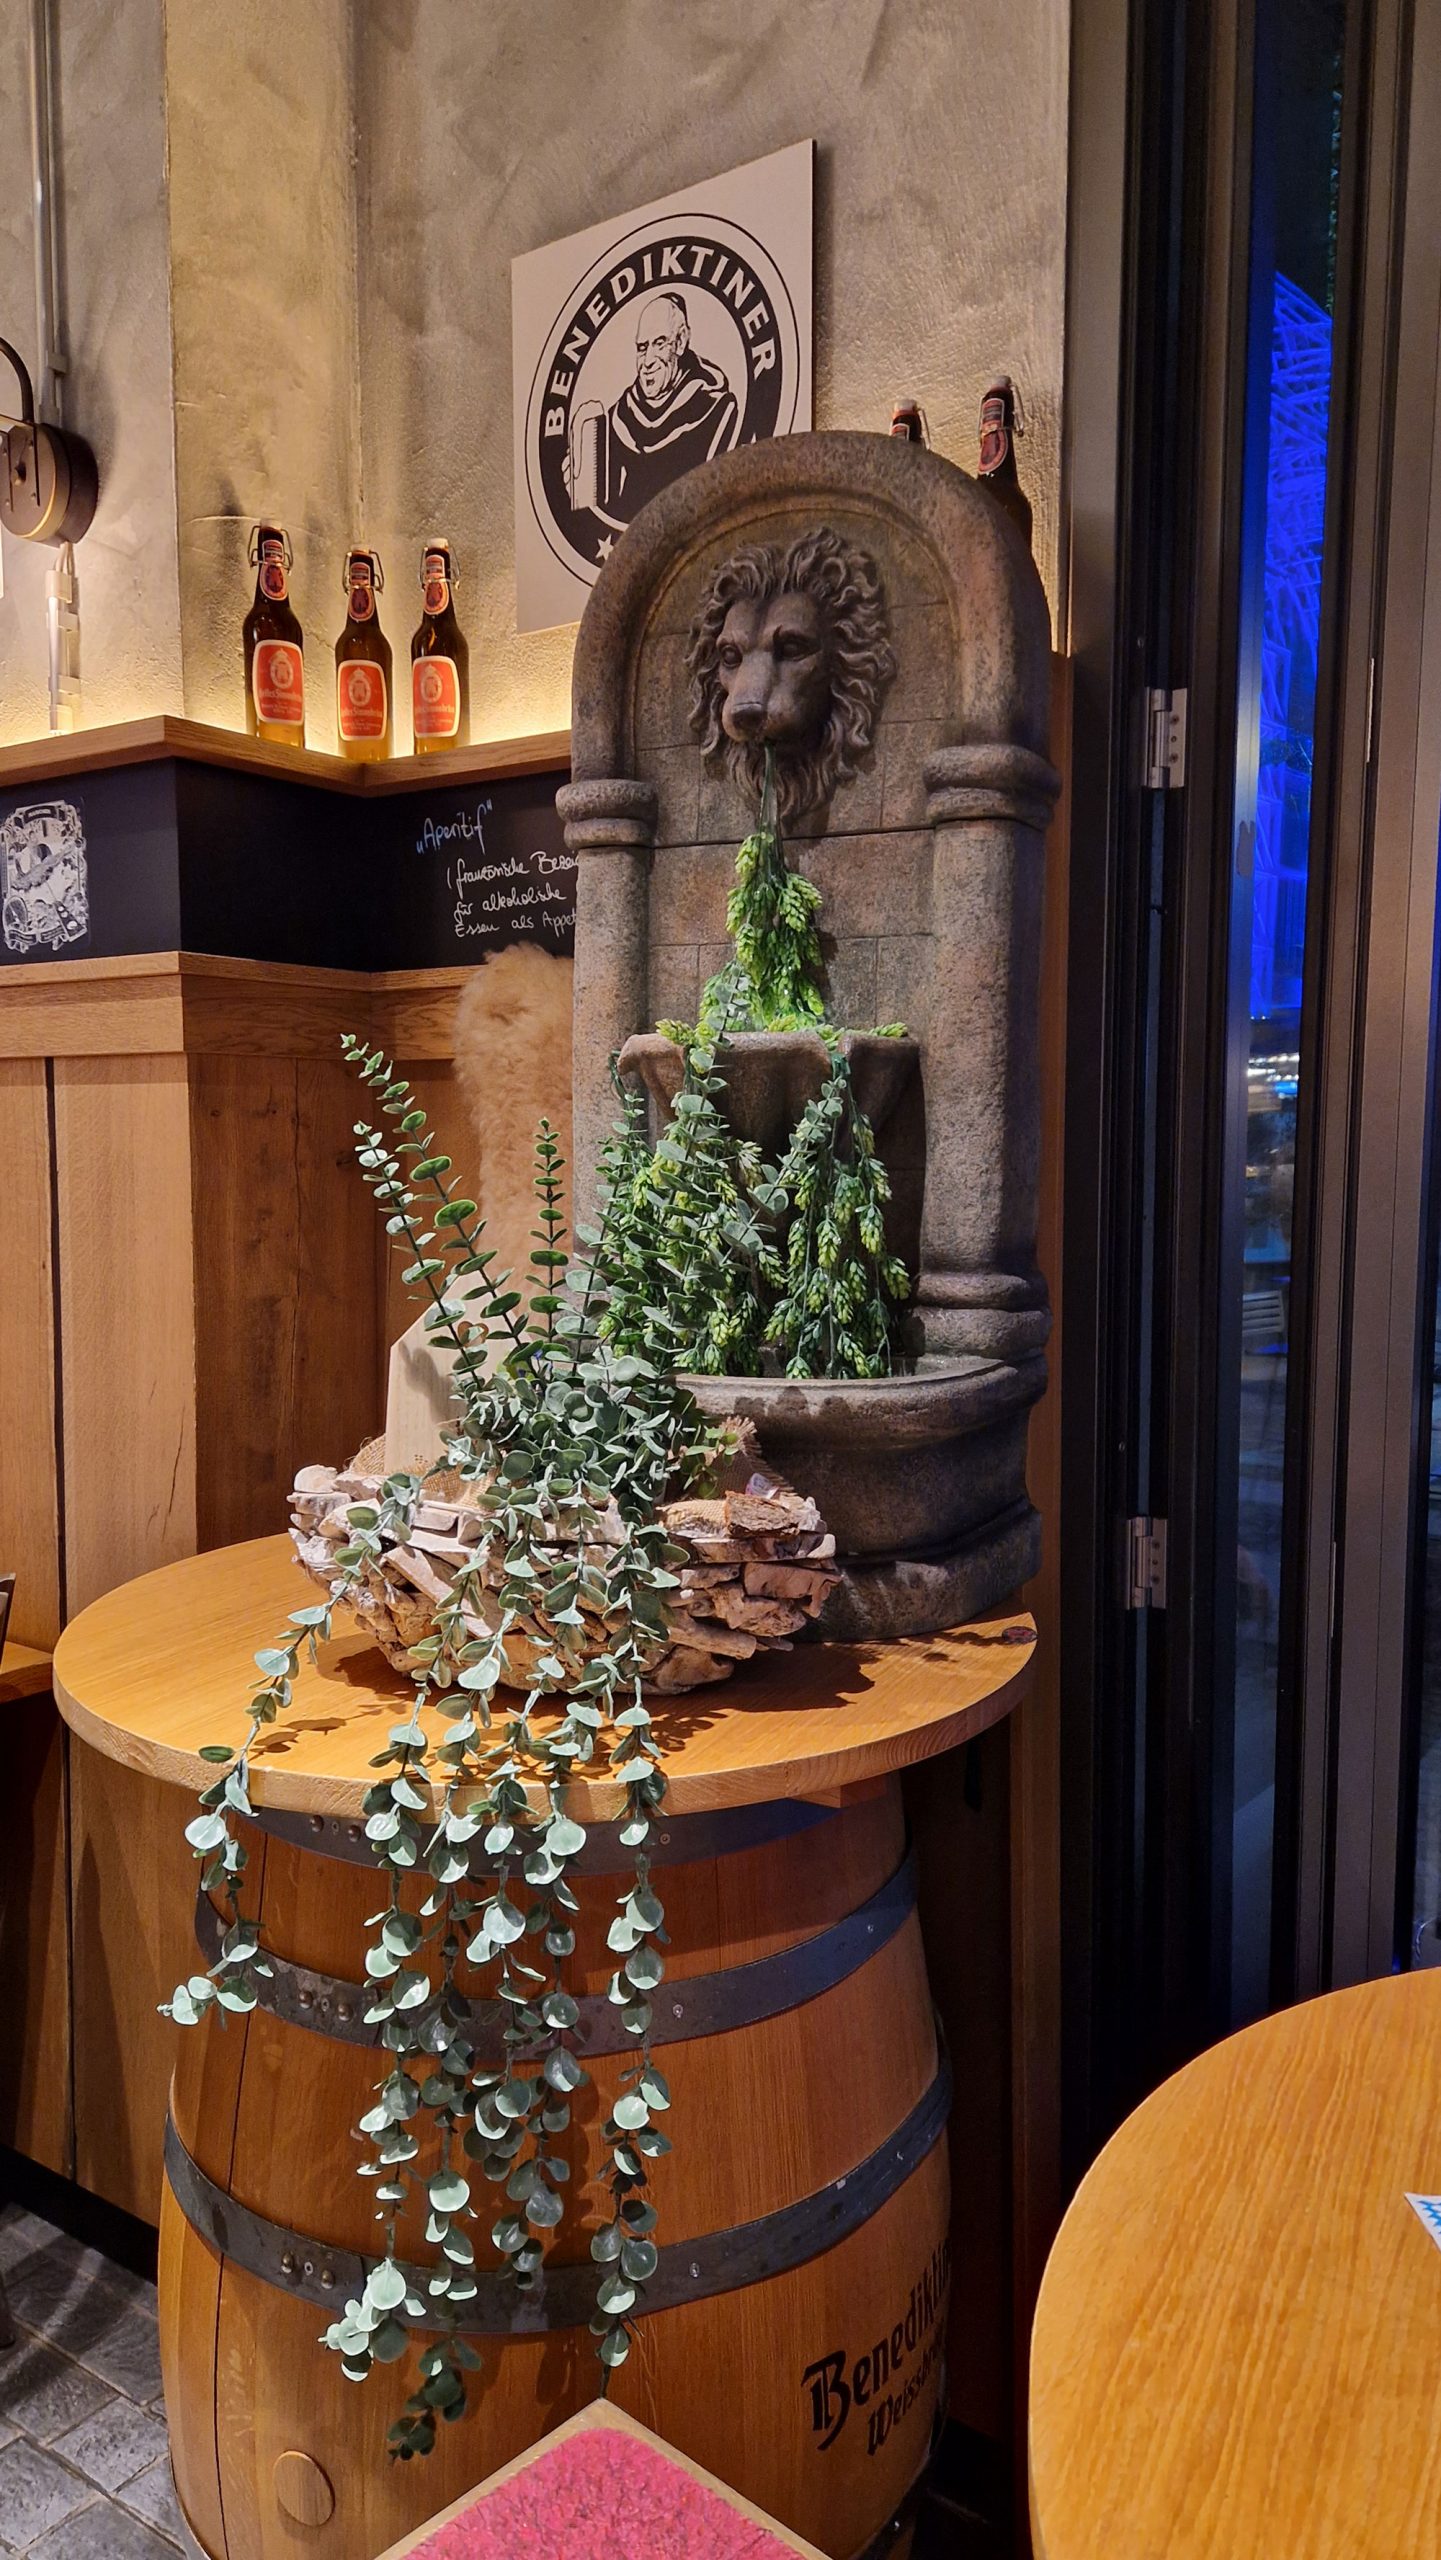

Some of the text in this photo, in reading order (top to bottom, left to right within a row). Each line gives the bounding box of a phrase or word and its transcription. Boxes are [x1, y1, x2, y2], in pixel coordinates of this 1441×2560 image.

[544, 243, 777, 438] BENEDIKTINER
[482, 882, 567, 911] alkoholische
[455, 921, 500, 938] Essen
[511, 914, 535, 930] als
